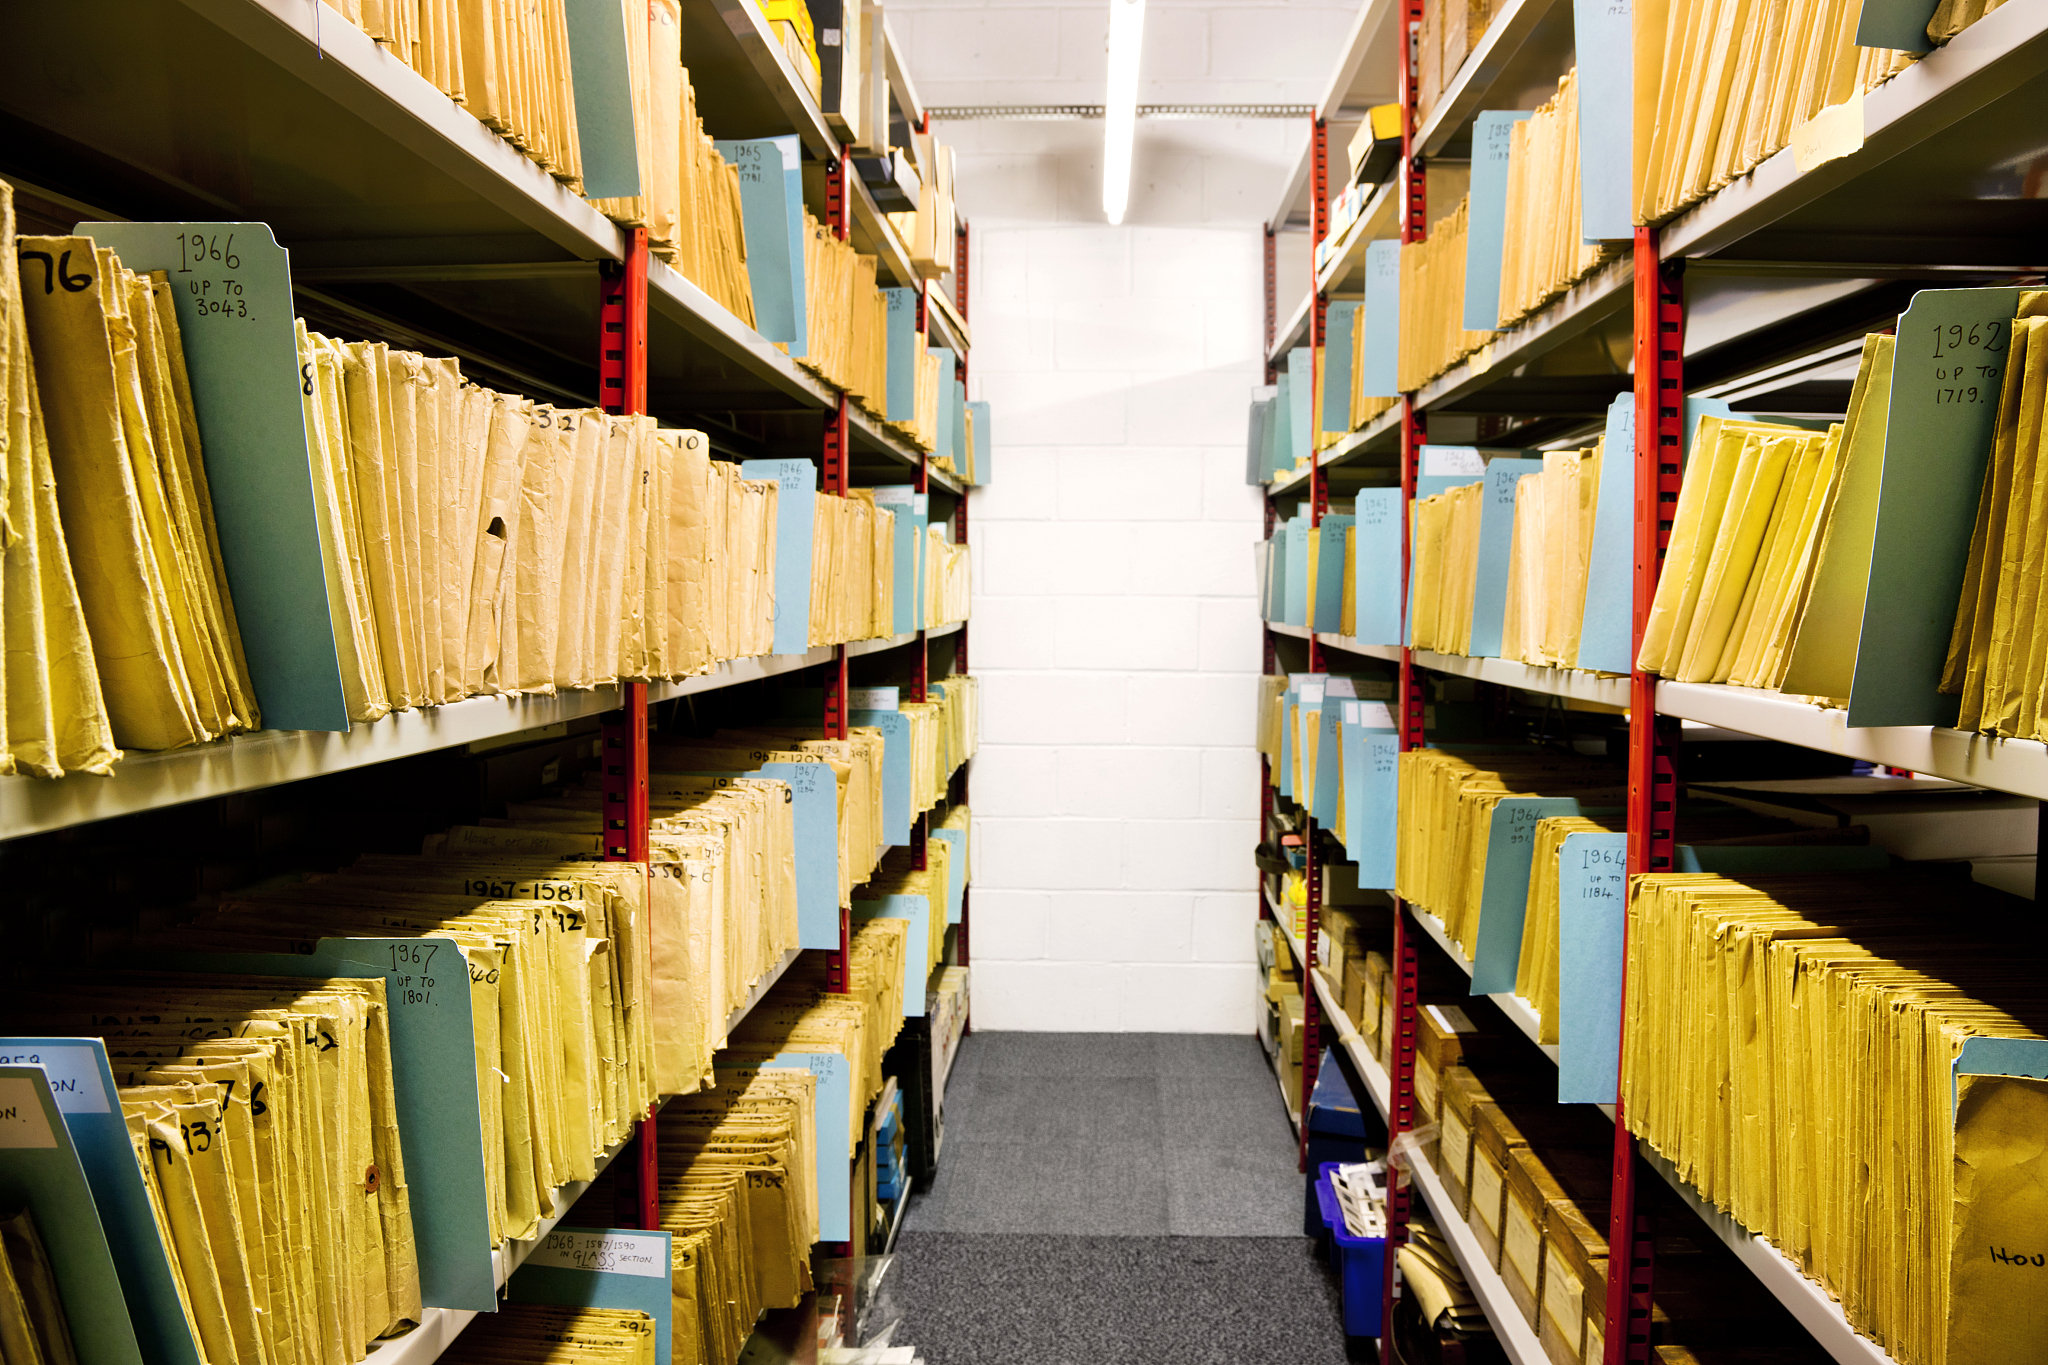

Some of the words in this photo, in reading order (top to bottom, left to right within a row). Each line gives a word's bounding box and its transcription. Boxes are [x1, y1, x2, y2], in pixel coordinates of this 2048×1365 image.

[1488, 123, 1510, 140] 195
[734, 145, 761, 162] 1965
[177, 232, 241, 273] 1966
[18, 249, 93, 295] 76
[190, 279, 211, 297] UP
[222, 279, 243, 297] TO
[198, 299, 256, 322] 3043.
[1932, 321, 2004, 359] 1962
[1936, 366, 1963, 381] UP
[1976, 366, 1998, 379] TO
[678, 435, 699, 450] 10
[779, 463, 802, 476] 1966
[794, 765, 819, 779] 1967
[1509, 807, 1546, 824] 1964
[1582, 849, 1627, 870] 1964
[1590, 875, 1602, 883] UP
[1609, 875, 1621, 883] TO
[389, 944, 439, 974] 1967
[397, 976, 411, 988] UP
[420, 976, 435, 988] TO
[810, 1056, 833, 1070] 1968
[546, 1234, 574, 1250] 1968
[572, 1250, 616, 1268] GLASS
